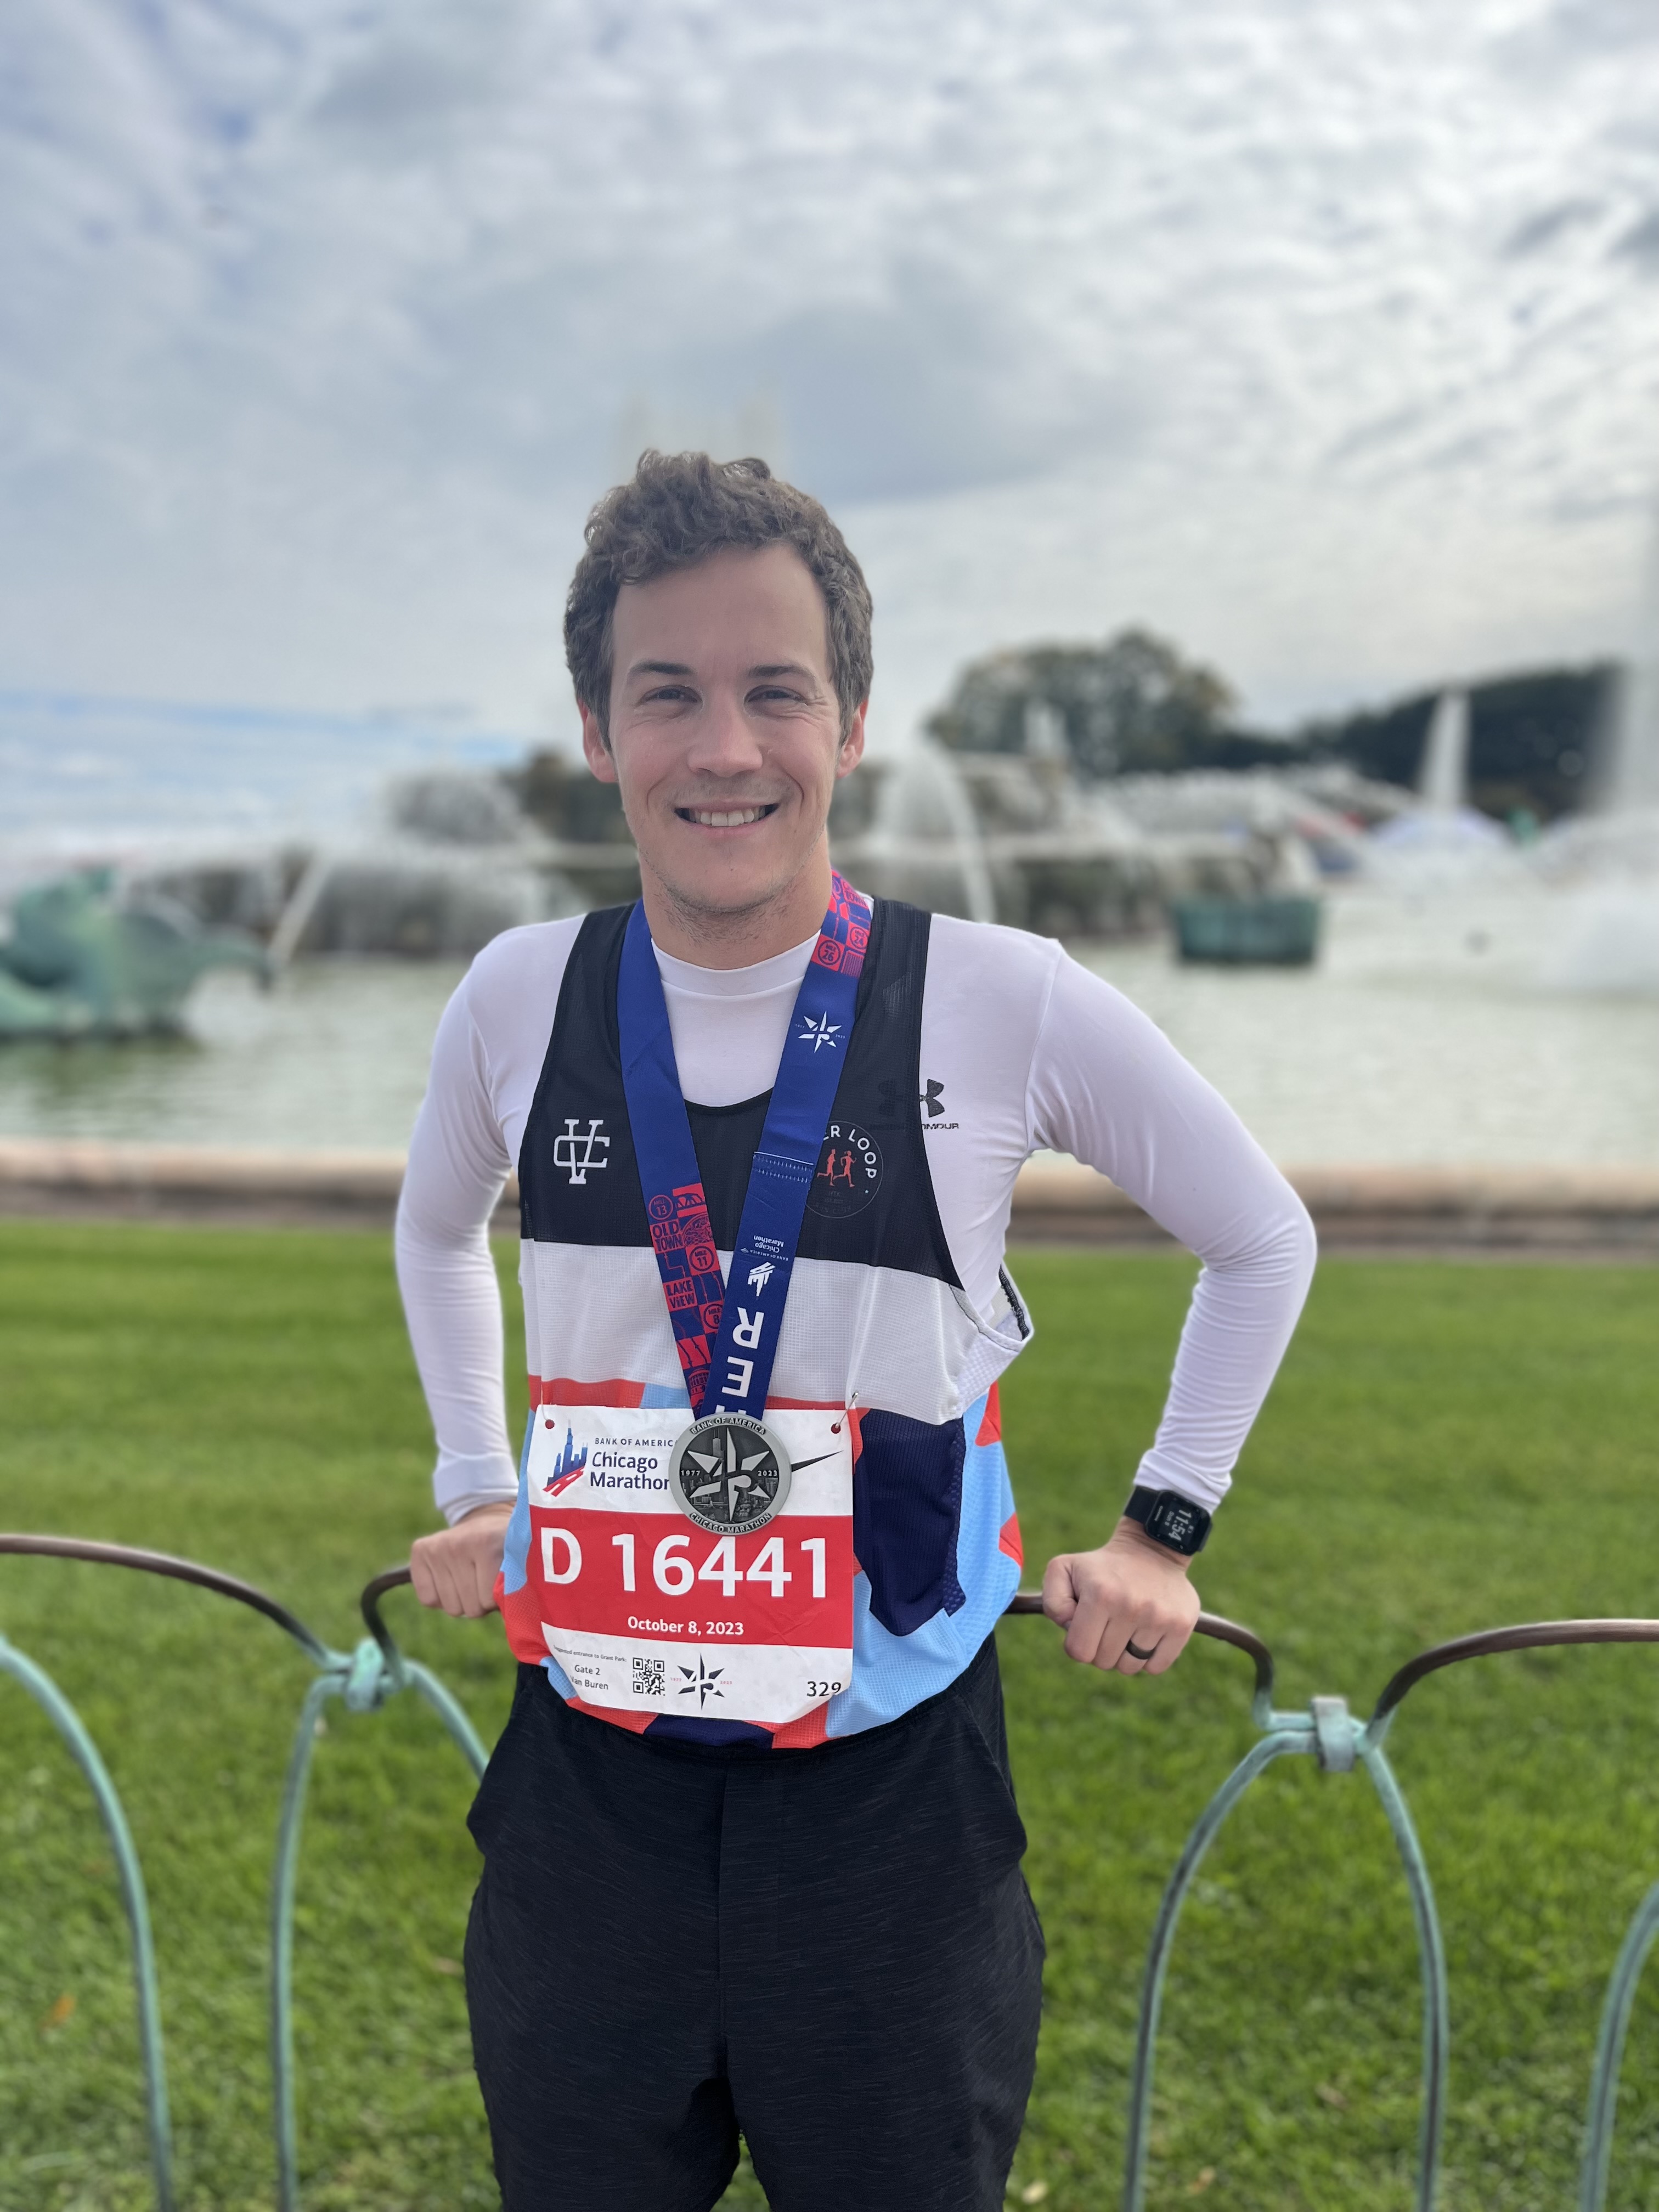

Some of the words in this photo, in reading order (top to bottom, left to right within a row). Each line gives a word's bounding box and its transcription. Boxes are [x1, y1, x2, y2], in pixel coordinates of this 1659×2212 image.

[821, 950, 834, 962] 26
[848, 1129, 877, 1178] LOOP
[656, 1205, 667, 1215] 13
[653, 1221, 679, 1238] OLD
[655, 1234, 683, 1251] TOWN
[753, 1235, 784, 1247] Marathon
[755, 1242, 780, 1253] Chicago
[697, 1256, 707, 1267] 11
[666, 1280, 693, 1296] LAKE
[691, 1419, 713, 1435] BANK
[729, 1418, 766, 1435] AMERICA
[592, 1452, 658, 1473] Chicago
[690, 1513, 724, 1532] CHICAGO
[727, 1514, 771, 1533] MARATHON
[1169, 1510, 1192, 1541] 11:54
[541, 1527, 582, 1584] D
[612, 1533, 826, 1598] 16441
[628, 1616, 684, 1634] October
[689, 1622, 702, 1637] 8,
[706, 1622, 744, 1635] 2023
[574, 1664, 594, 1675] Gate
[585, 1679, 608, 1690] Buren
[806, 1681, 841, 1697] 329
